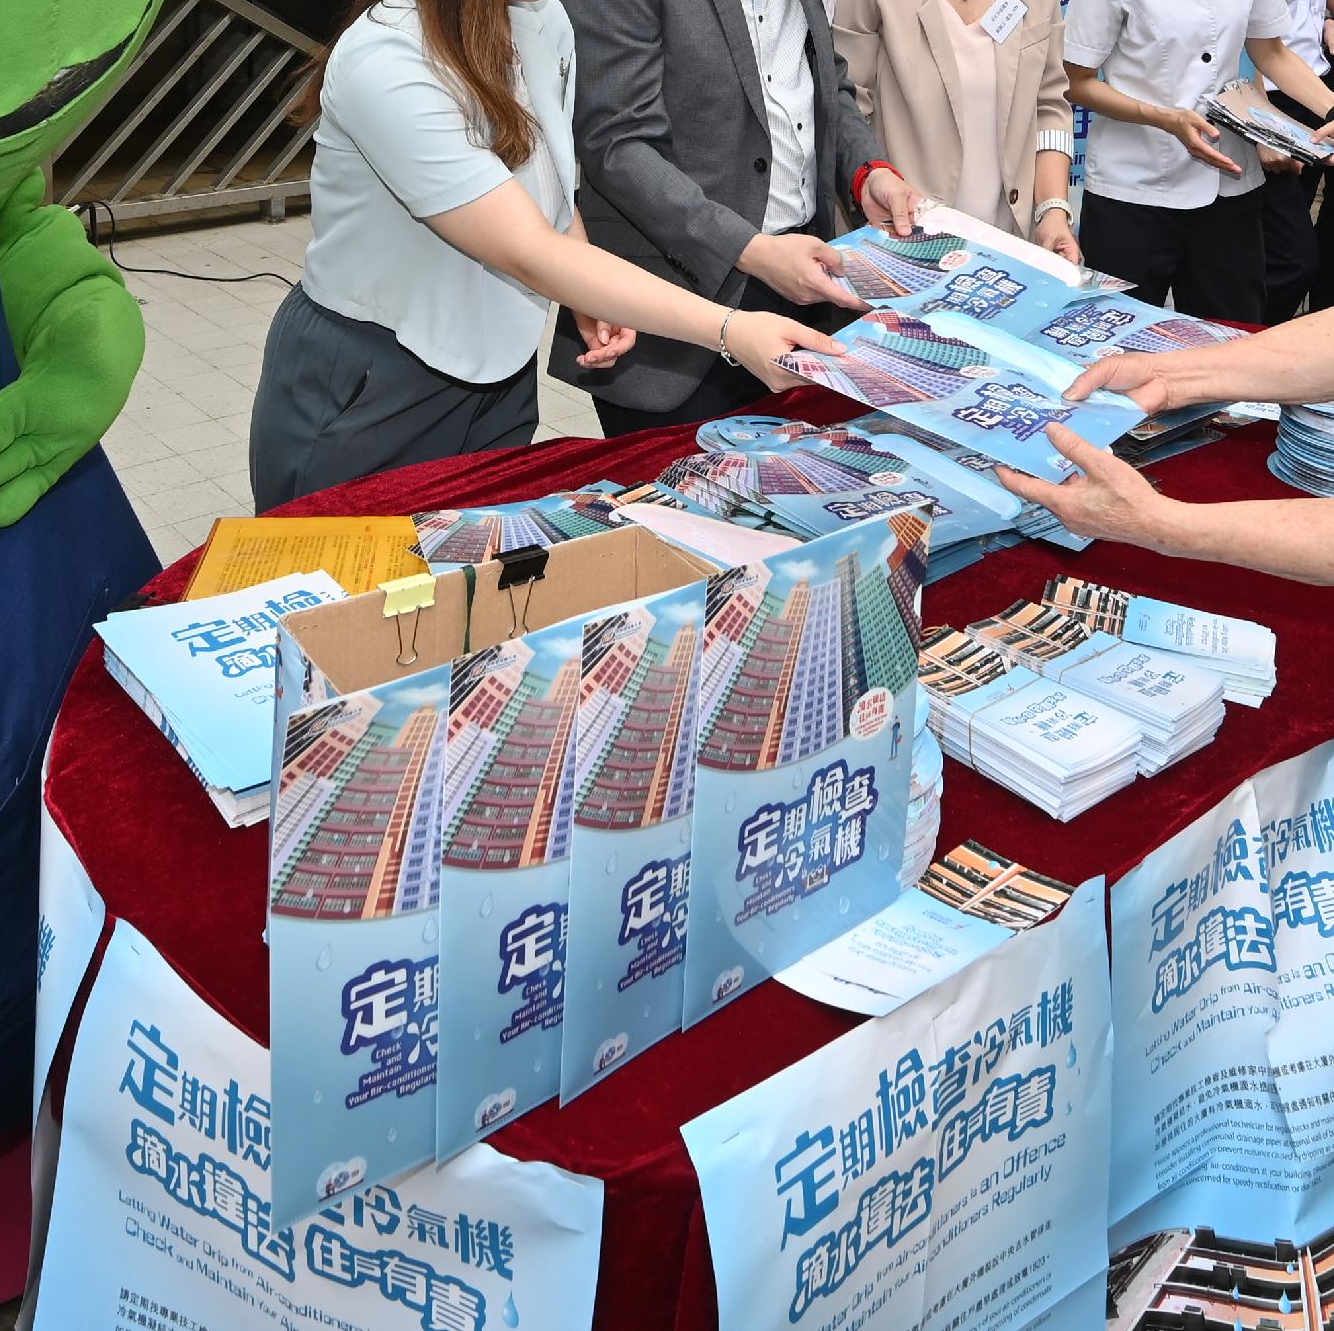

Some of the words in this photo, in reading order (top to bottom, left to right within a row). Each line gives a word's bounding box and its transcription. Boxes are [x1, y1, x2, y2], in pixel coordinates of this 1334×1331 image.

[171, 589, 327, 657] 定期檢
[741, 765, 874, 875] 定期檢查
[773, 817, 862, 888] 冷氣機
[505, 910, 568, 986] 定
[1154, 910, 1275, 1012] 滴水違法
[1198, 991, 1219, 1013] Drip
[1303, 960, 1324, 980] an
[406, 1008, 439, 1065] 冷
[1195, 1005, 1246, 1034] Maintain
[362, 1064, 402, 1088] Maintain
[375, 1041, 403, 1061] Check
[386, 1052, 403, 1066] and
[348, 1090, 370, 1107] Your
[370, 1061, 436, 1098] Air-conditioner
[398, 1070, 436, 1096] Regularl
[775, 977, 1074, 1252] 定期檢查冷氣機
[979, 1171, 1000, 1194] an
[1002, 1131, 1067, 1179] Offence
[991, 1162, 1053, 1211] Regularly
[124, 1216, 175, 1258] Check
[195, 1254, 256, 1310] Maintain
[156, 1210, 200, 1249] Water
[202, 1240, 230, 1269] Drip
[790, 1159, 933, 1323] 滴水違法
